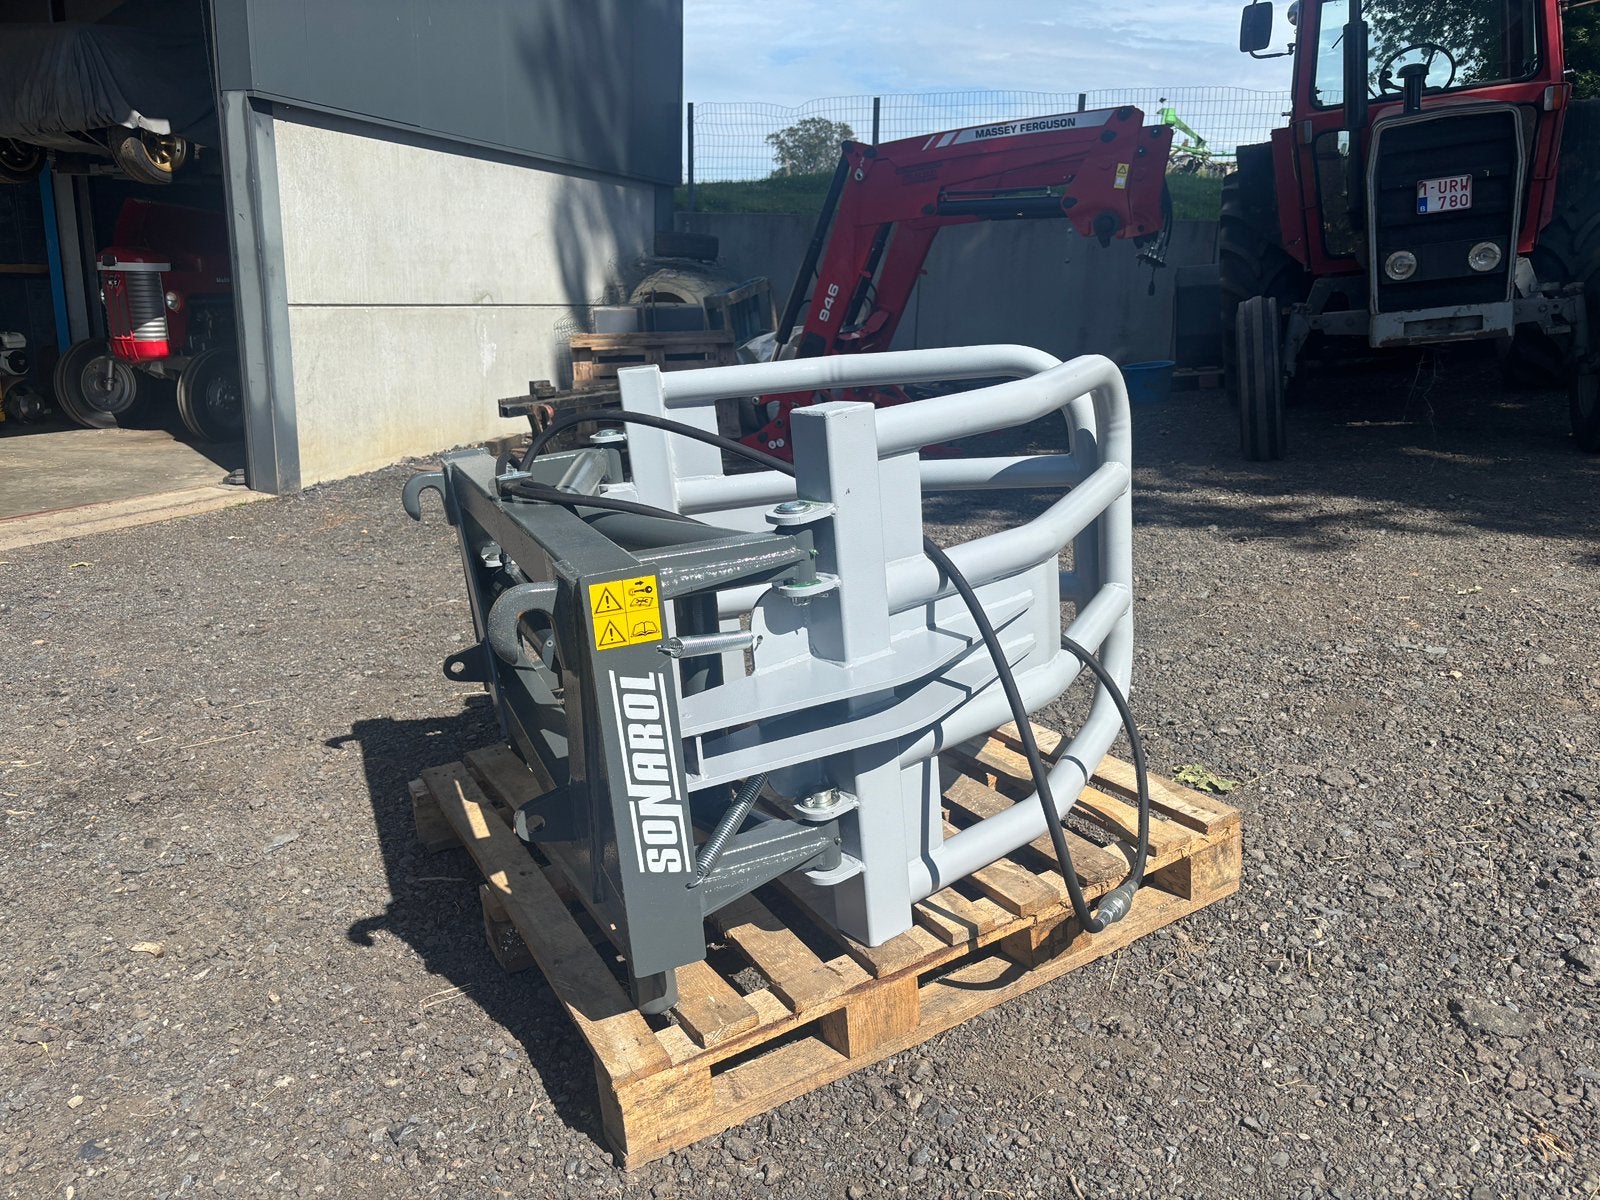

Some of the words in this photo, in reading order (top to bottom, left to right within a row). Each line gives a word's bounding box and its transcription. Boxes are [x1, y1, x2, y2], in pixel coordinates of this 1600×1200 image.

[975, 124, 1017, 139] MASSEY
[1020, 117, 1076, 133] FERGUSON
[1419, 177, 1469, 196] 1-URW
[1438, 194, 1469, 209] 780
[818, 283, 839, 322] 946
[618, 671, 684, 874] SONAROL
